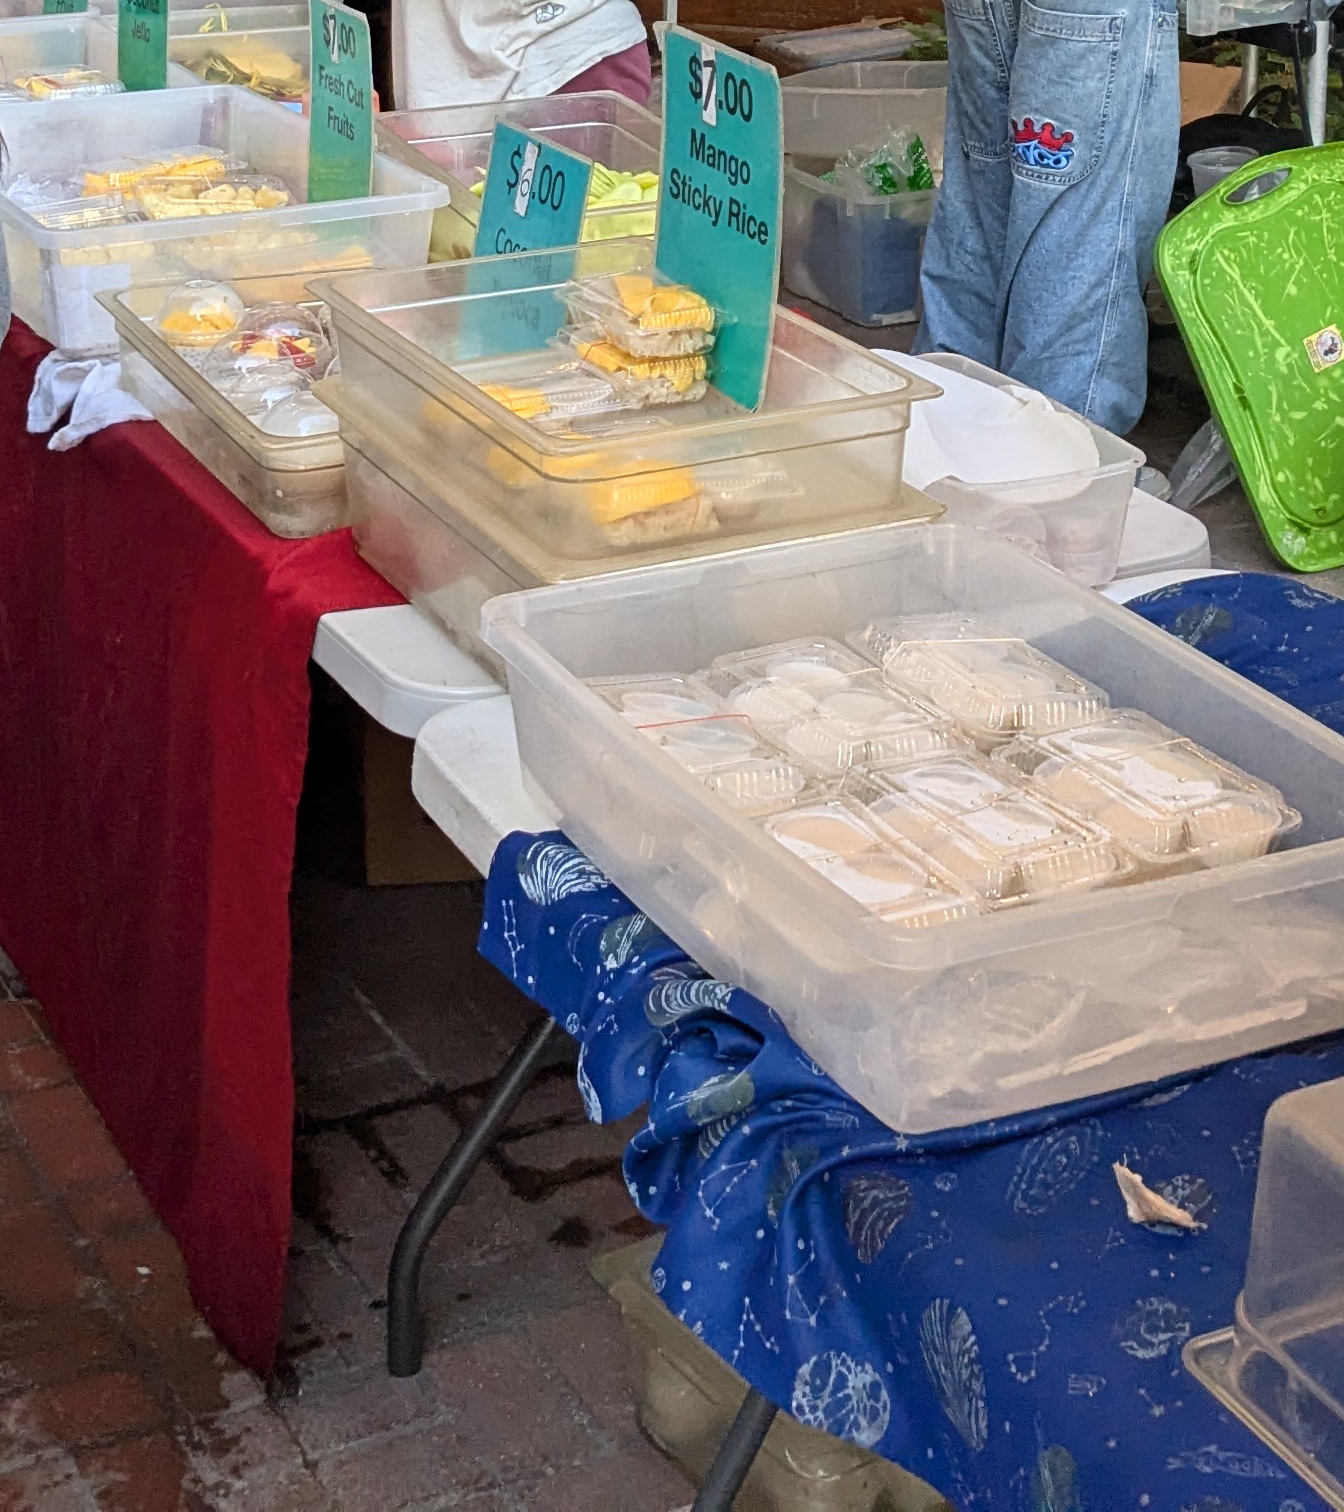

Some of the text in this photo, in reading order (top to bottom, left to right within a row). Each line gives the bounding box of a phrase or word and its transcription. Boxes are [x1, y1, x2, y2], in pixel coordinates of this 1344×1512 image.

[322, 11, 356, 59] $7.00
[318, 64, 365, 110] Fresh Cut
[688, 52, 753, 123] $7.00
[327, 105, 355, 142] Fruits
[506, 143, 566, 212] $6.00
[689, 127, 751, 187] Mango
[668, 168, 769, 246] Sticky Rice
